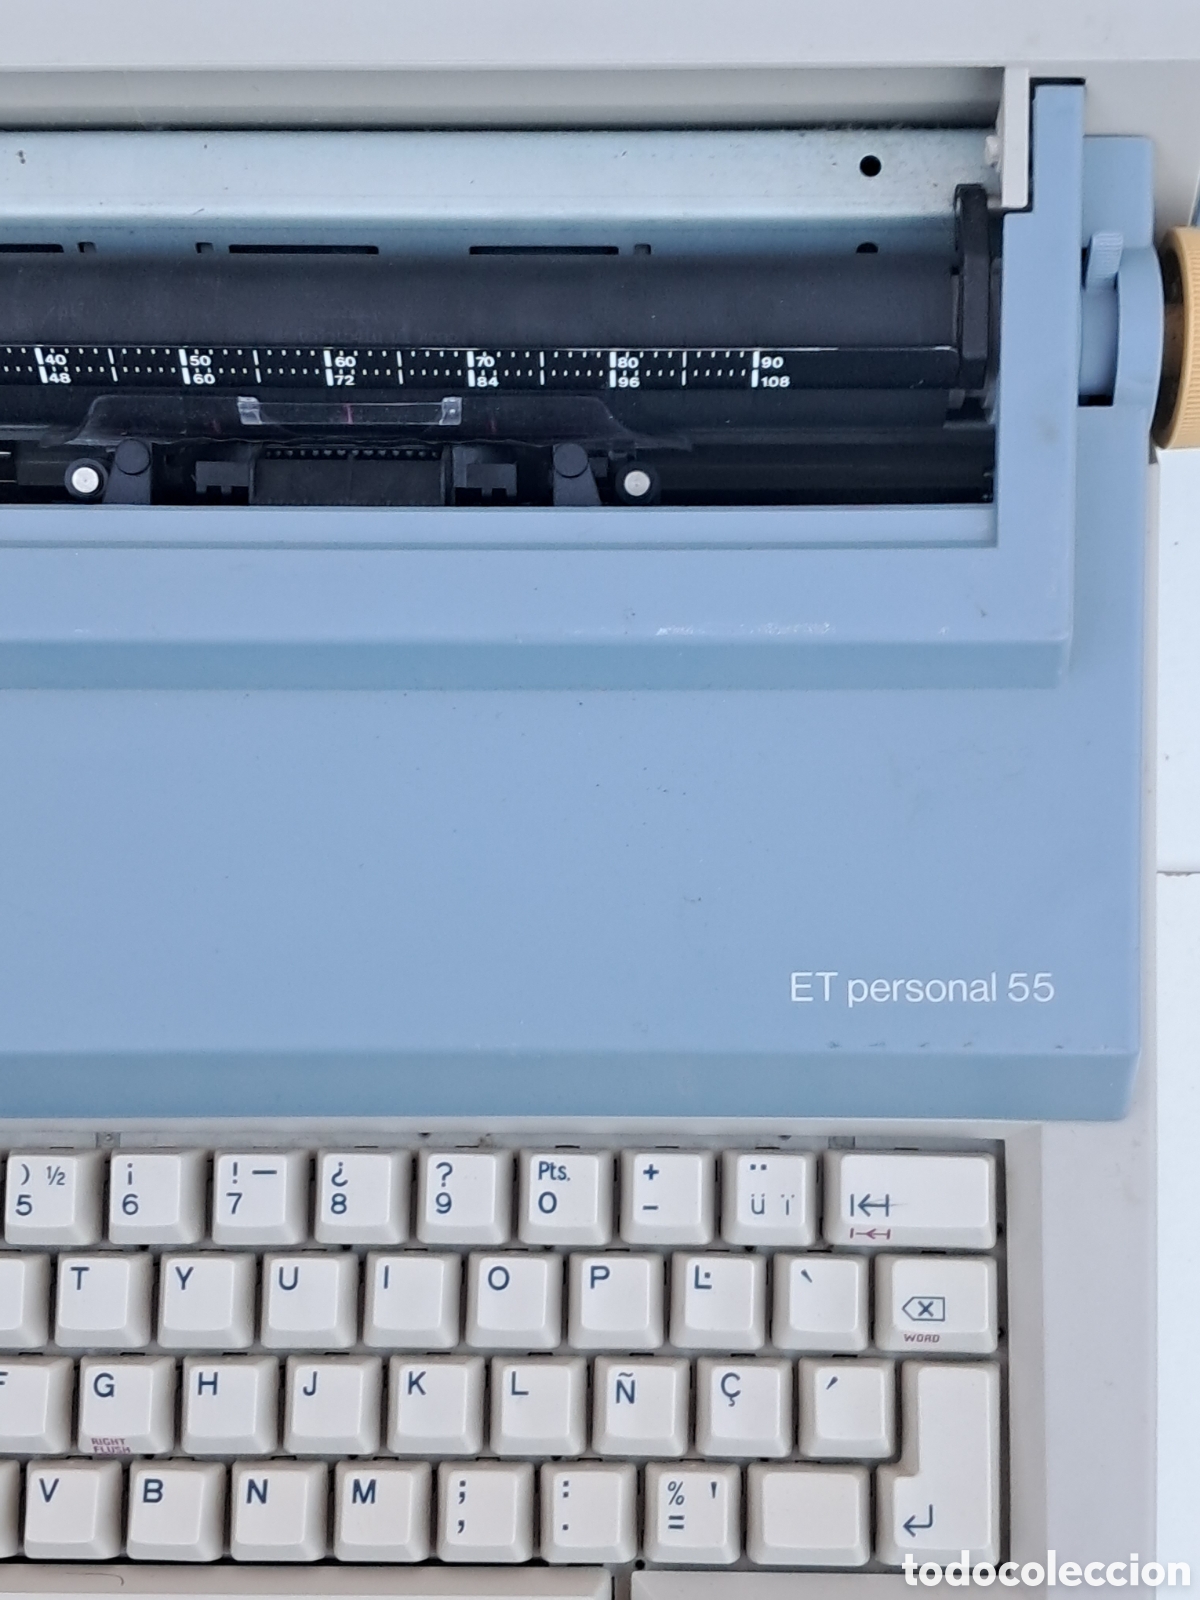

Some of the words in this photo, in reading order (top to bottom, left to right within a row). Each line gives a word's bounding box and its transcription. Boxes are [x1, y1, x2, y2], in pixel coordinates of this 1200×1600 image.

[45, 354, 67, 366] 40
[190, 355, 212, 367] 50
[334, 356, 357, 368] 60
[475, 356, 495, 368] 70
[617, 356, 640, 369] 80
[761, 356, 784, 369] 90
[49, 373, 71, 385] 48
[193, 373, 216, 385] 60
[334, 374, 356, 386] 72
[477, 376, 499, 388] 84
[618, 376, 640, 388] 96
[761, 376, 790, 388] 108
[791, 971, 839, 1002] ET
[847, 972, 997, 1008] personal
[1007, 972, 1055, 1003] 55
[21, 1163, 31, 1186] )
[232, 1161, 238, 1184] !
[435, 1161, 453, 1188] ?
[538, 1160, 571, 1182] Pts.
[15, 1194, 33, 1217] 5
[121, 1193, 139, 1216] 6
[226, 1192, 243, 1215] 7
[330, 1192, 348, 1215] 8
[435, 1192, 452, 1215] 9
[70, 1266, 90, 1291] T
[175, 1266, 194, 1291] Y
[278, 1266, 299, 1291] U
[487, 1265, 510, 1291] O
[590, 1265, 611, 1290] P
[904, 1333, 940, 1343] WORD
[93, 1372, 115, 1398] G
[197, 1371, 218, 1396] H
[302, 1371, 318, 1397] J
[407, 1371, 426, 1396] K
[511, 1371, 529, 1396] L
[615, 1372, 636, 1405] Ñ
[720, 1372, 741, 1408] Ç
[91, 1437, 126, 1446] RIGHT
[39, 1478, 60, 1503] V
[142, 1478, 164, 1504] B
[246, 1478, 268, 1504] N
[352, 1478, 377, 1504] M
[667, 1480, 685, 1506] %
